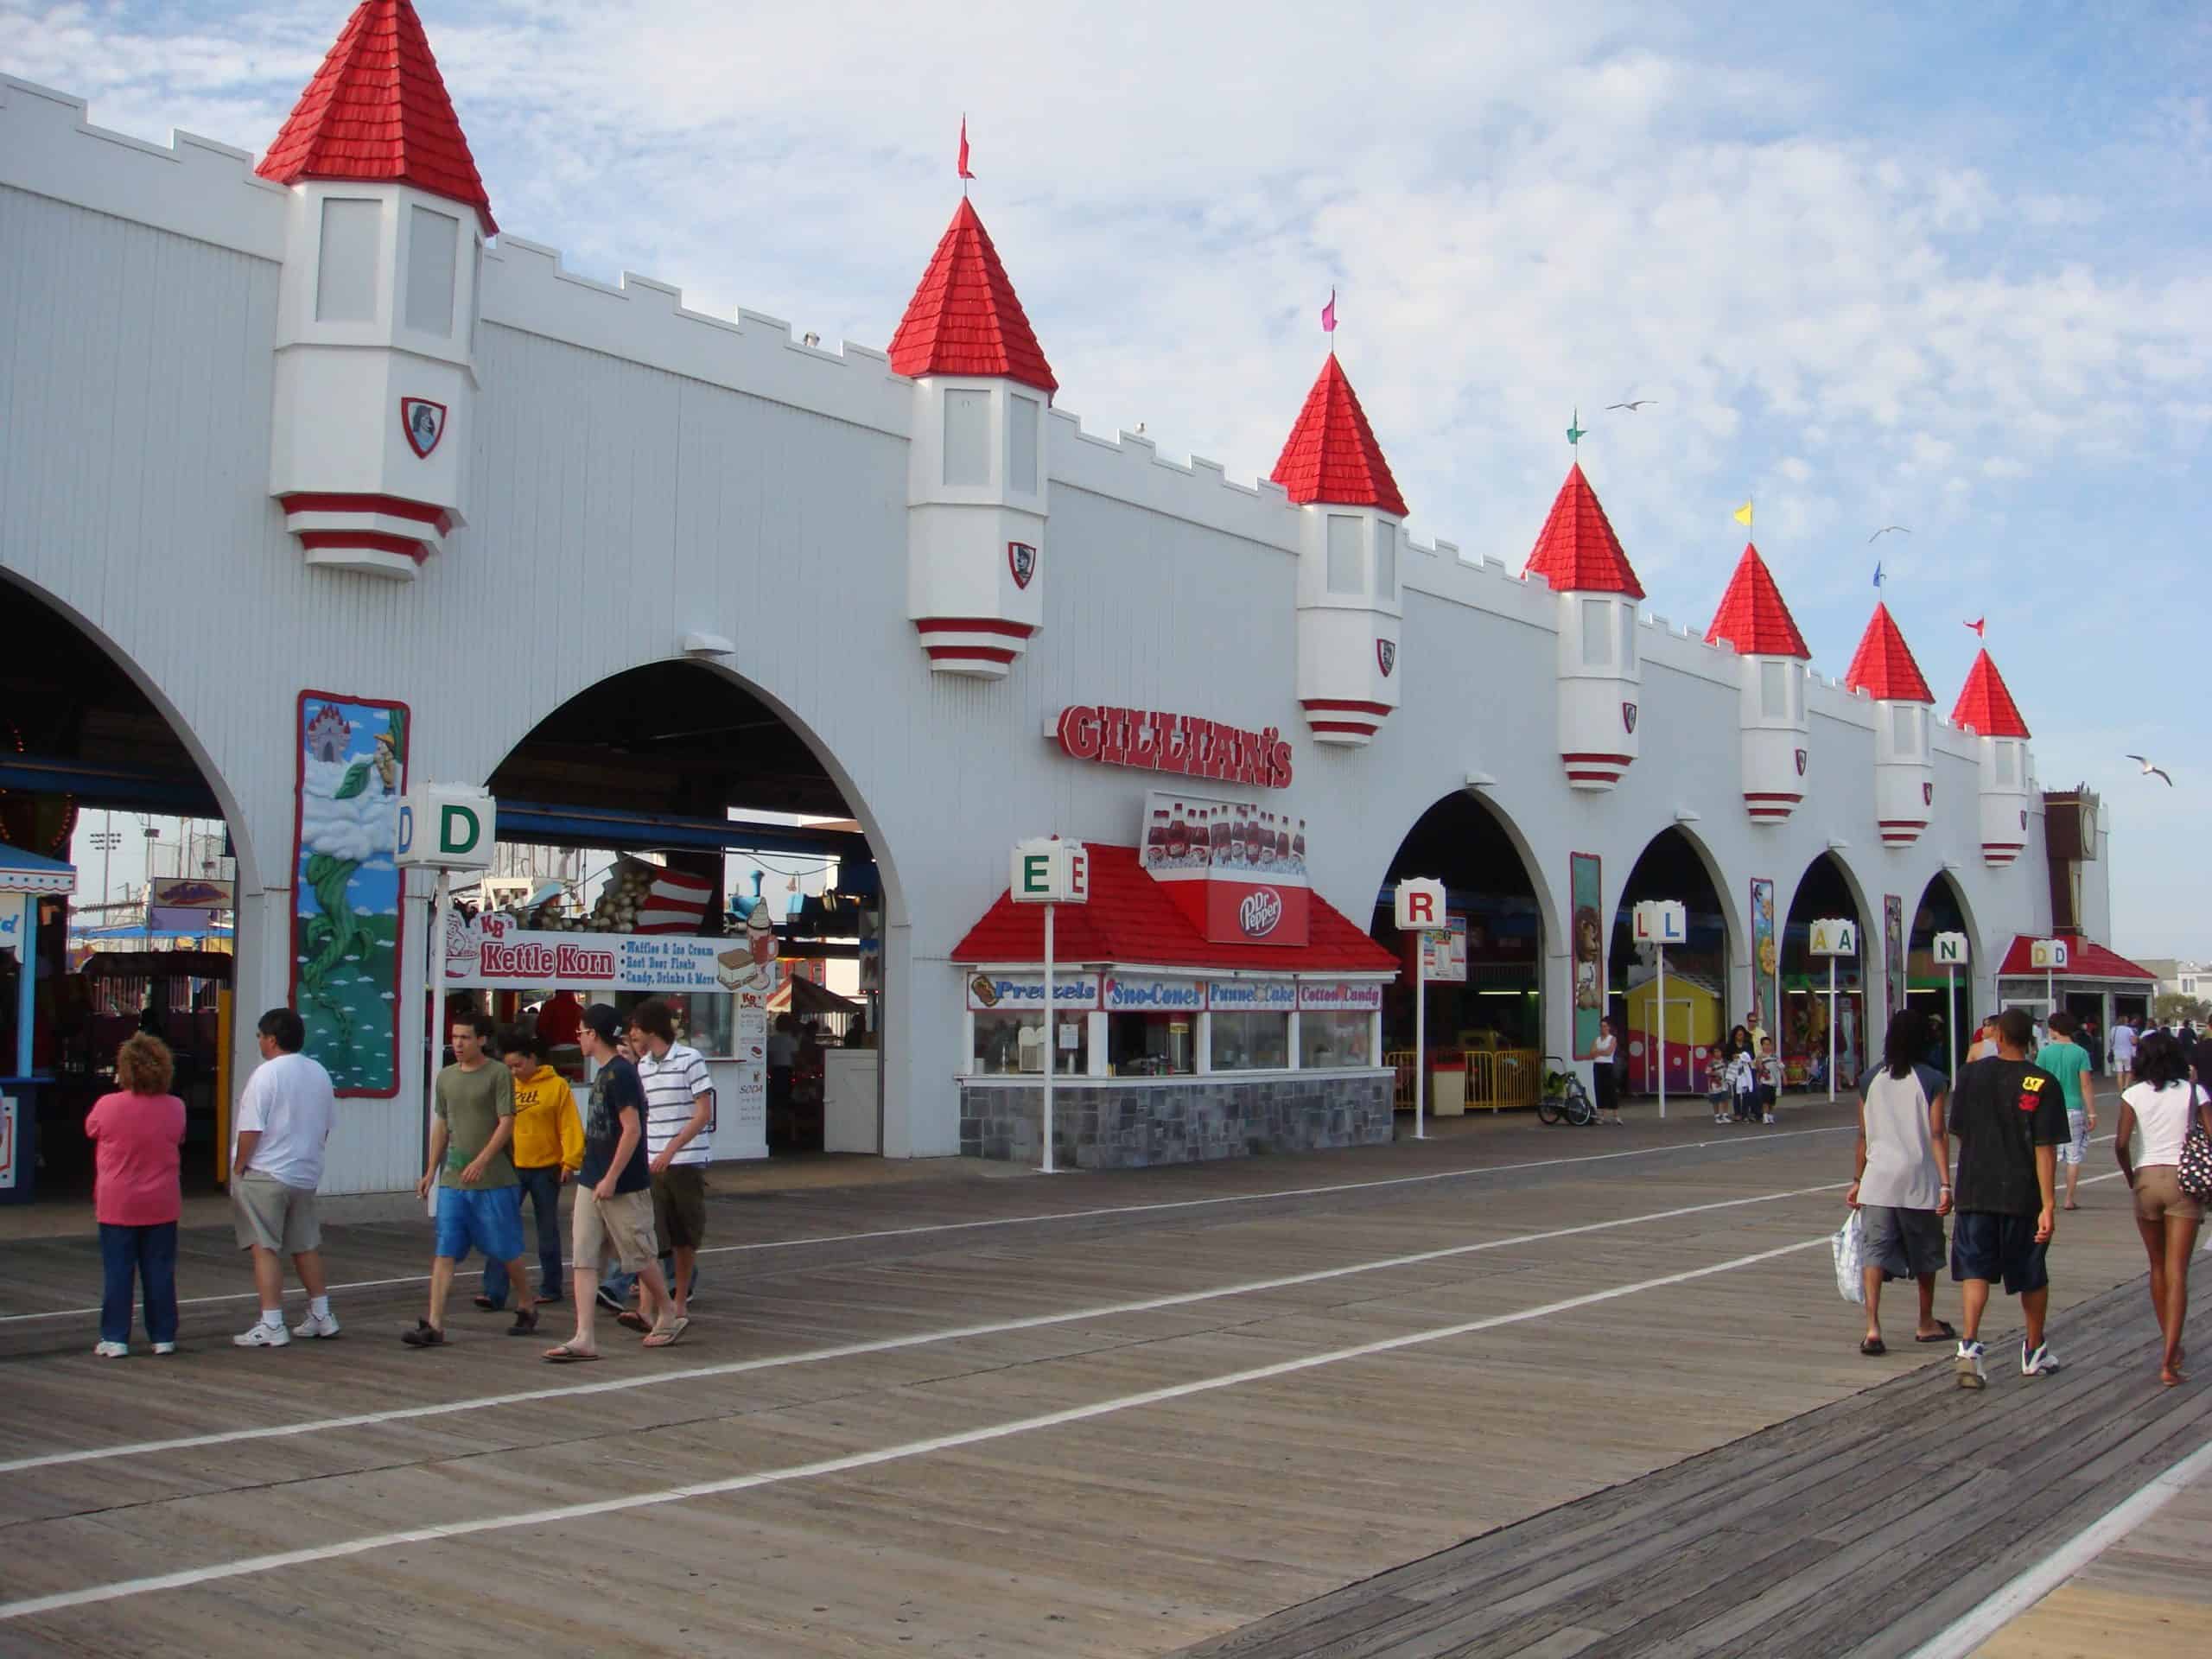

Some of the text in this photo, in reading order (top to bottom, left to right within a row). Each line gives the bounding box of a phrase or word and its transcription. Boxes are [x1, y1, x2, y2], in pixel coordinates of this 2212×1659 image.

[1058, 705, 1292, 788] GILLIAN'S
[397, 805, 413, 855] D
[439, 804, 480, 854] D
[1024, 855, 1050, 893] E
[1072, 857, 1084, 893] E
[1244, 896, 1280, 931] Pepper
[1255, 892, 1269, 912] Dr
[1409, 893, 1433, 922] R
[1637, 913, 1648, 938] L
[1665, 912, 1680, 938] L
[688, 943, 714, 956] Cream
[1813, 928, 1827, 950] A
[1839, 930, 1852, 950] A
[1941, 941, 1956, 959] N
[480, 941, 615, 979] Kettle Korn
[2035, 947, 2046, 963] D
[2056, 947, 2066, 963] D
[1344, 987, 1379, 1006] Candy
